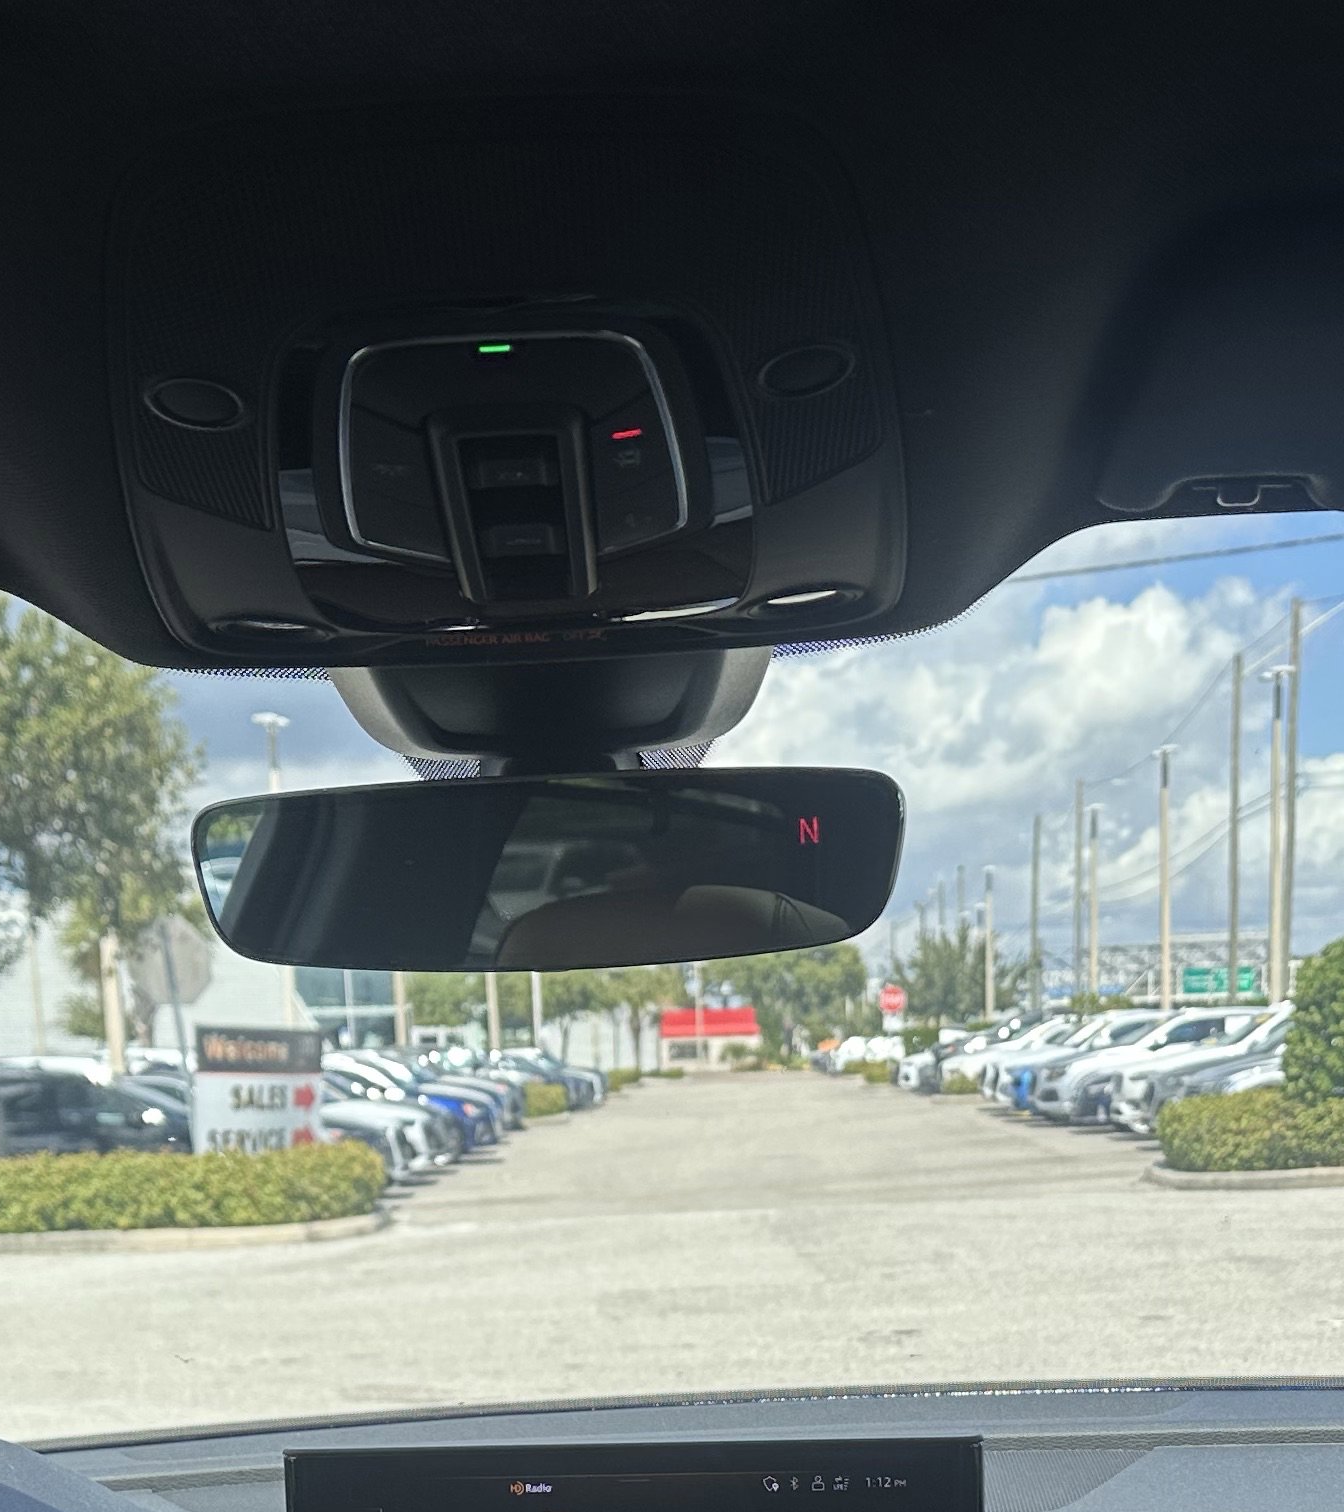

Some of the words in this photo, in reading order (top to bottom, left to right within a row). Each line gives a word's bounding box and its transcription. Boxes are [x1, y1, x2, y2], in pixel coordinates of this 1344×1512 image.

[799, 816, 820, 844] N
[230, 1083, 288, 1112] SALES
[525, 1483, 553, 1493] Radio
[865, 1476, 892, 1488] 1:12
[894, 1479, 907, 1488] PM
